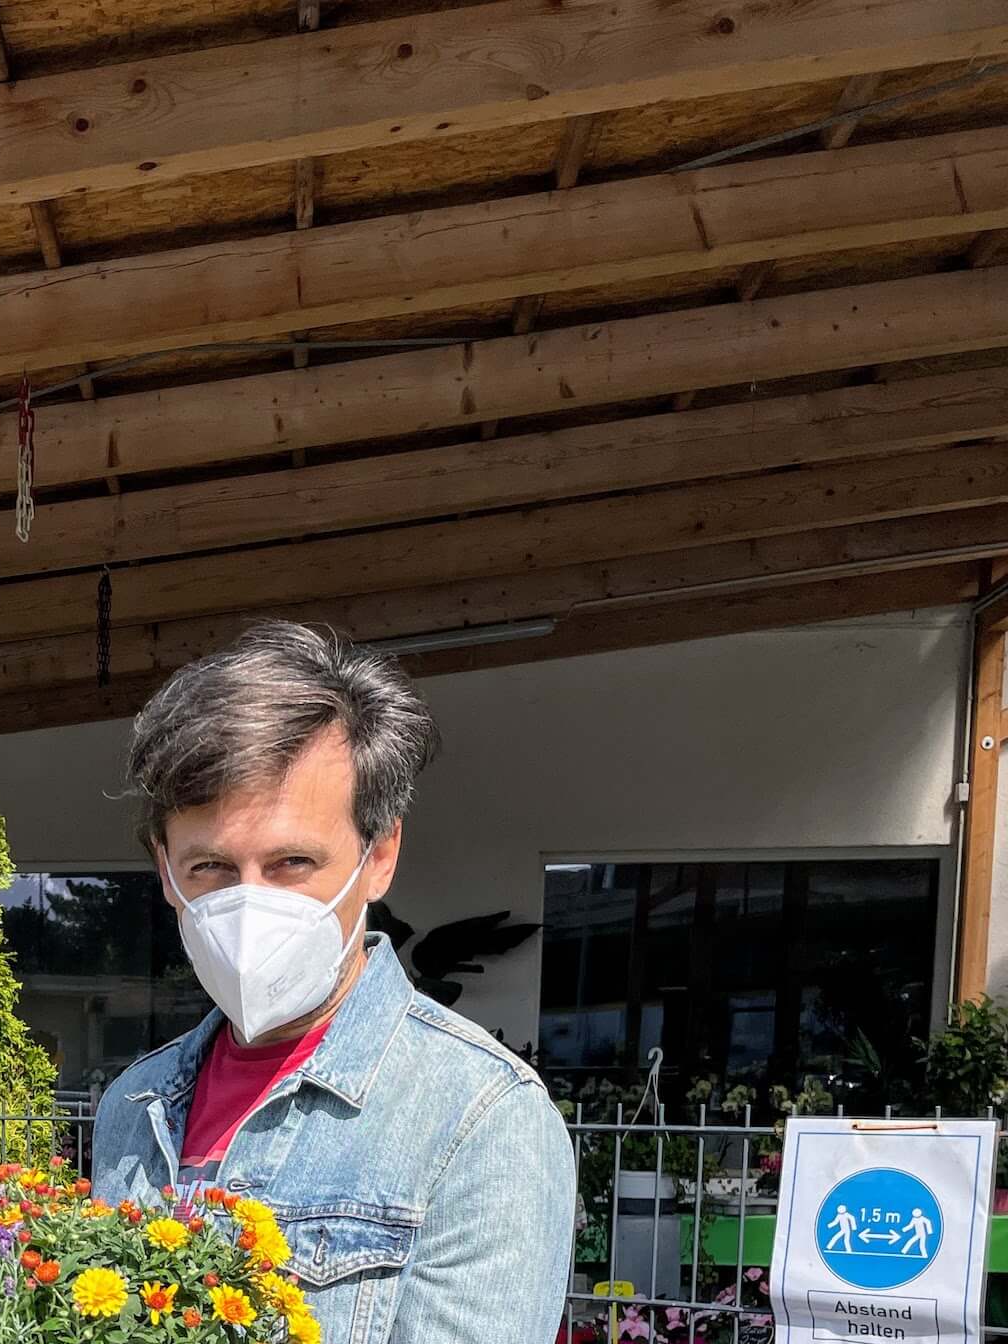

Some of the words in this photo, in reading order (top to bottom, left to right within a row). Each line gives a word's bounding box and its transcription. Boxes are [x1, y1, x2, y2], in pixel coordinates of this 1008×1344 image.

[885, 1212, 901, 1224] m
[834, 1299, 912, 1320] Abstand
[848, 1319, 905, 1340] halten
